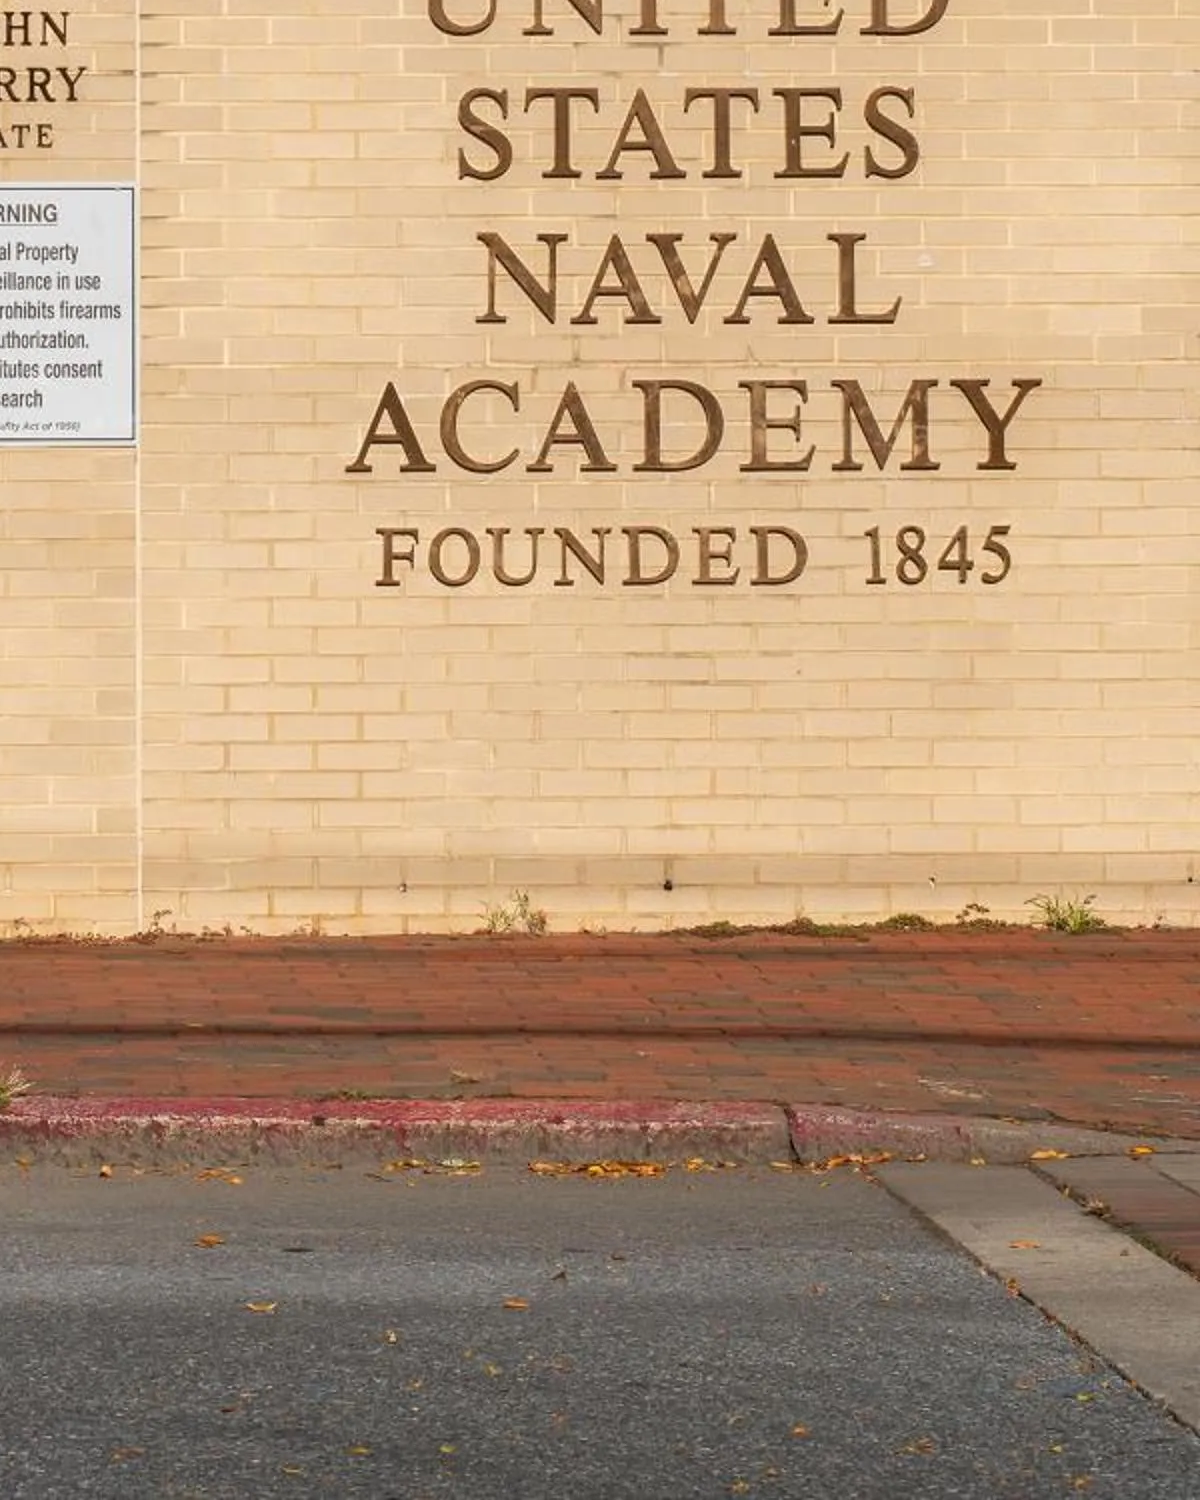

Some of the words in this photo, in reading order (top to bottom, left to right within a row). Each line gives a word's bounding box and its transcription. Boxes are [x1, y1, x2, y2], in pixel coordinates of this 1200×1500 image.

[457, 86, 920, 180] STATES
[16, 242, 79, 265] Property
[57, 272, 70, 290] in
[75, 275, 101, 290] use
[475, 233, 902, 325] NAVAL
[59, 301, 121, 320] firearms
[44, 359, 103, 379] consent
[346, 379, 1042, 473] ACADEMY
[375, 527, 808, 587] FOUNDED
[865, 525, 1012, 586] 1845
